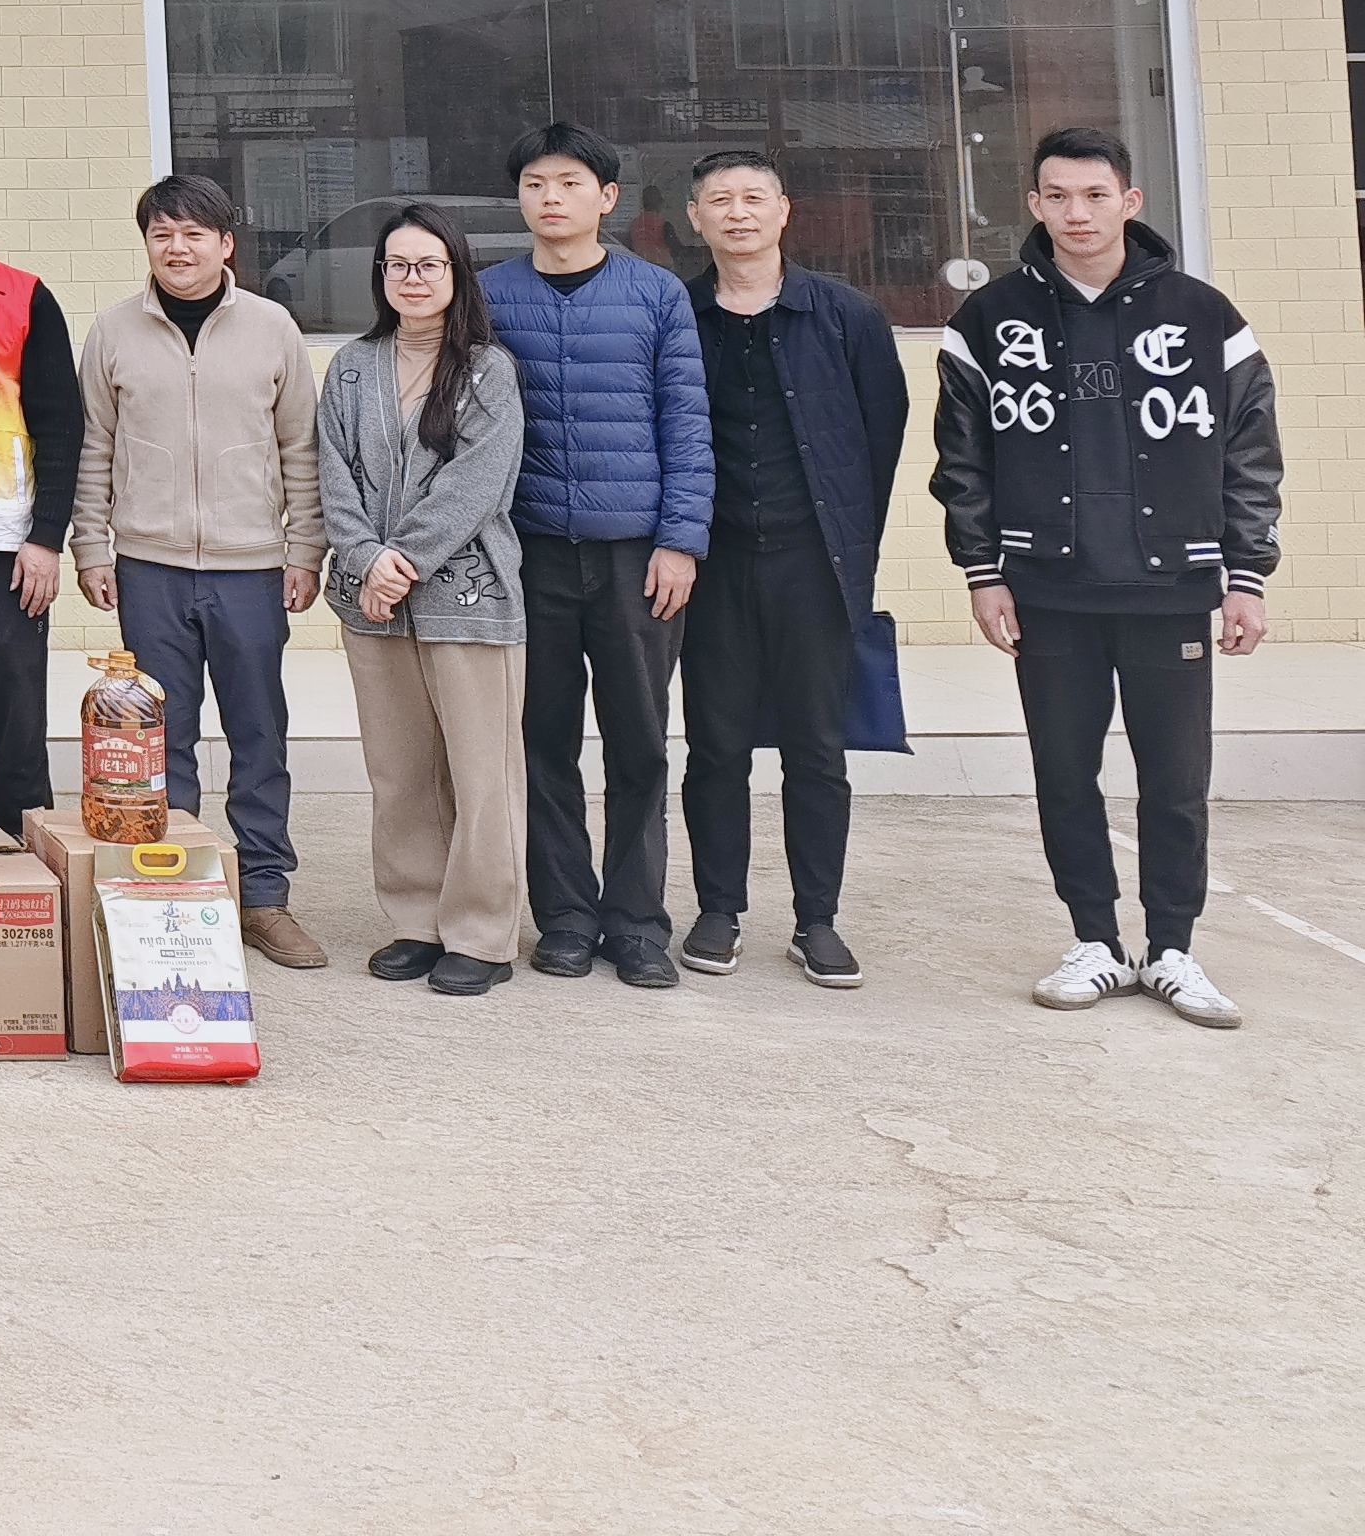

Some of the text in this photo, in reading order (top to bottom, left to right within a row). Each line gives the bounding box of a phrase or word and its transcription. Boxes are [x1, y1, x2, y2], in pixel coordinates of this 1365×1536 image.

[995, 319, 1053, 371] A
[1139, 384, 1216, 440] 04
[99, 759, 138, 774] 花生油
